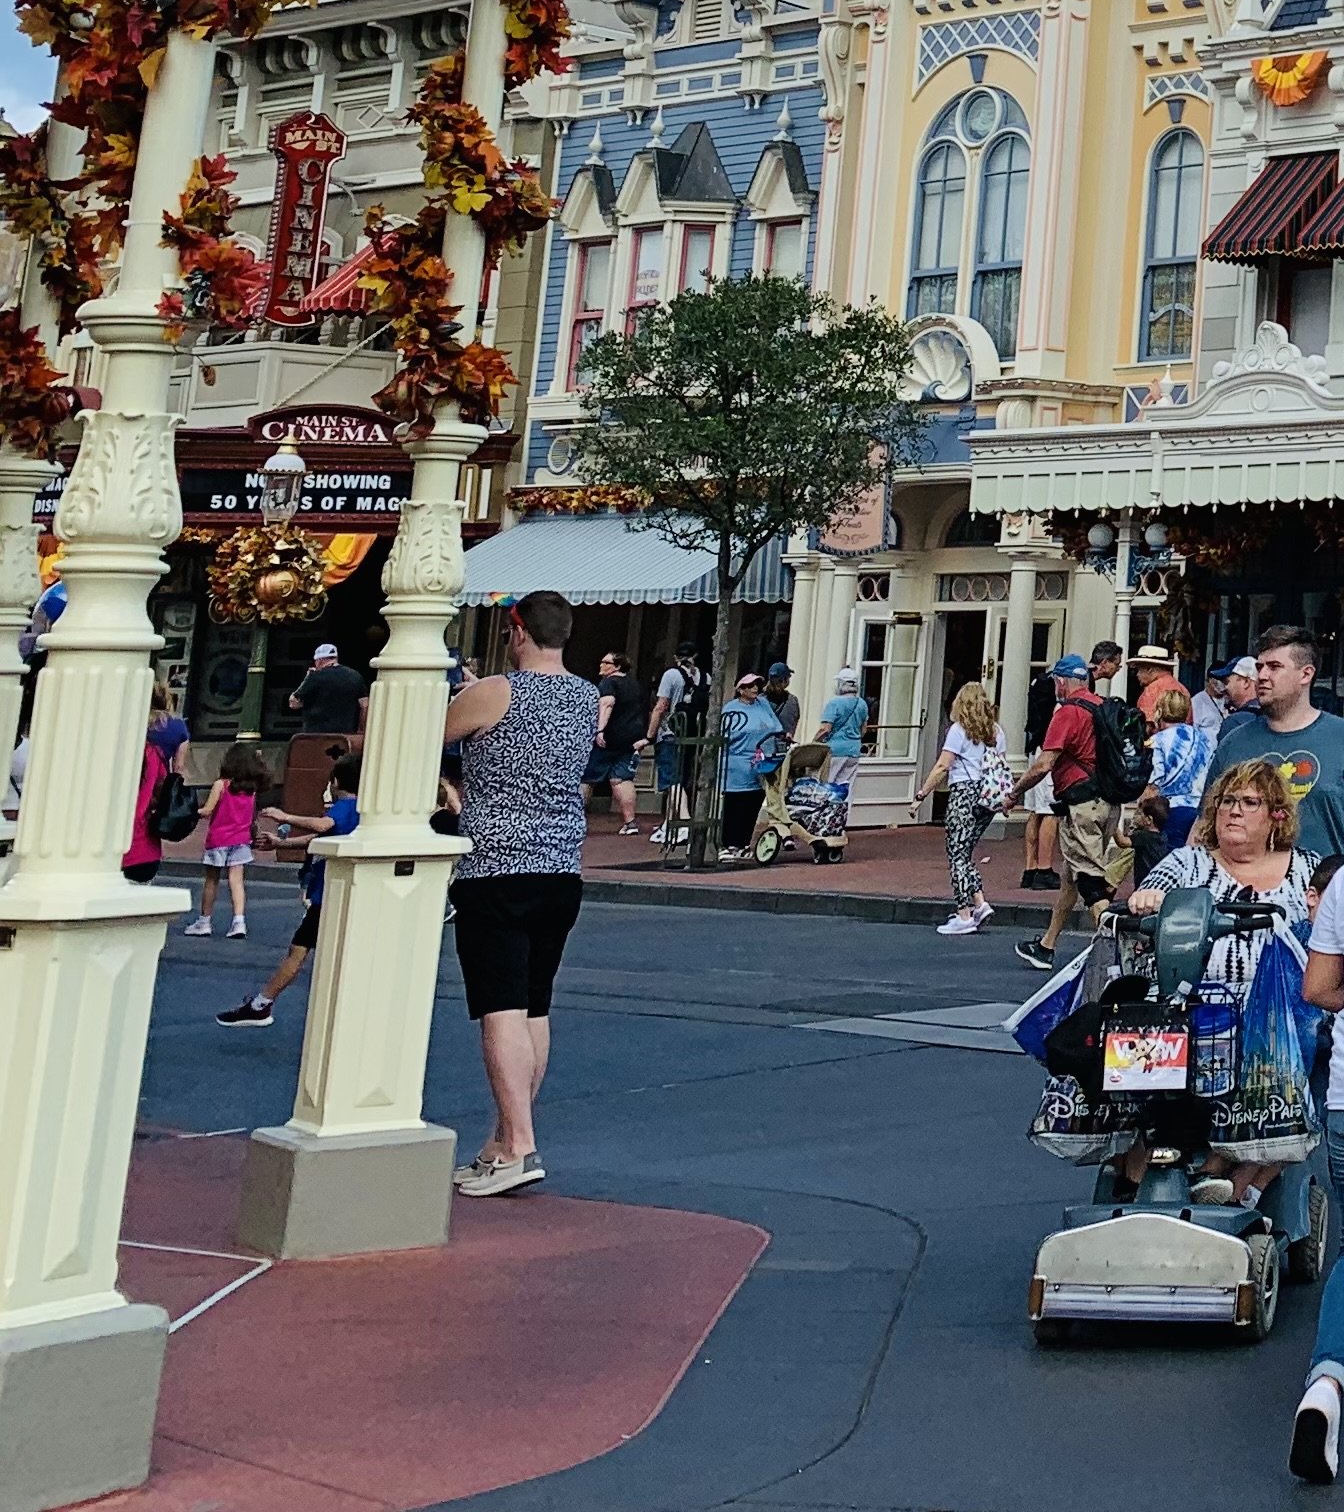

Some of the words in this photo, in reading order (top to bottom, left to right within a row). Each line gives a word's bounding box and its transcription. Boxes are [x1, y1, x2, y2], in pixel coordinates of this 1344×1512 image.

[284, 129, 338, 144] MAIN
[279, 157, 327, 302] CINEMA
[295, 415, 339, 427] MAIN
[261, 420, 390, 443] CINEMA
[303, 474, 391, 490] SHOWING
[209, 494, 238, 510] 50
[320, 496, 348, 510] OF
